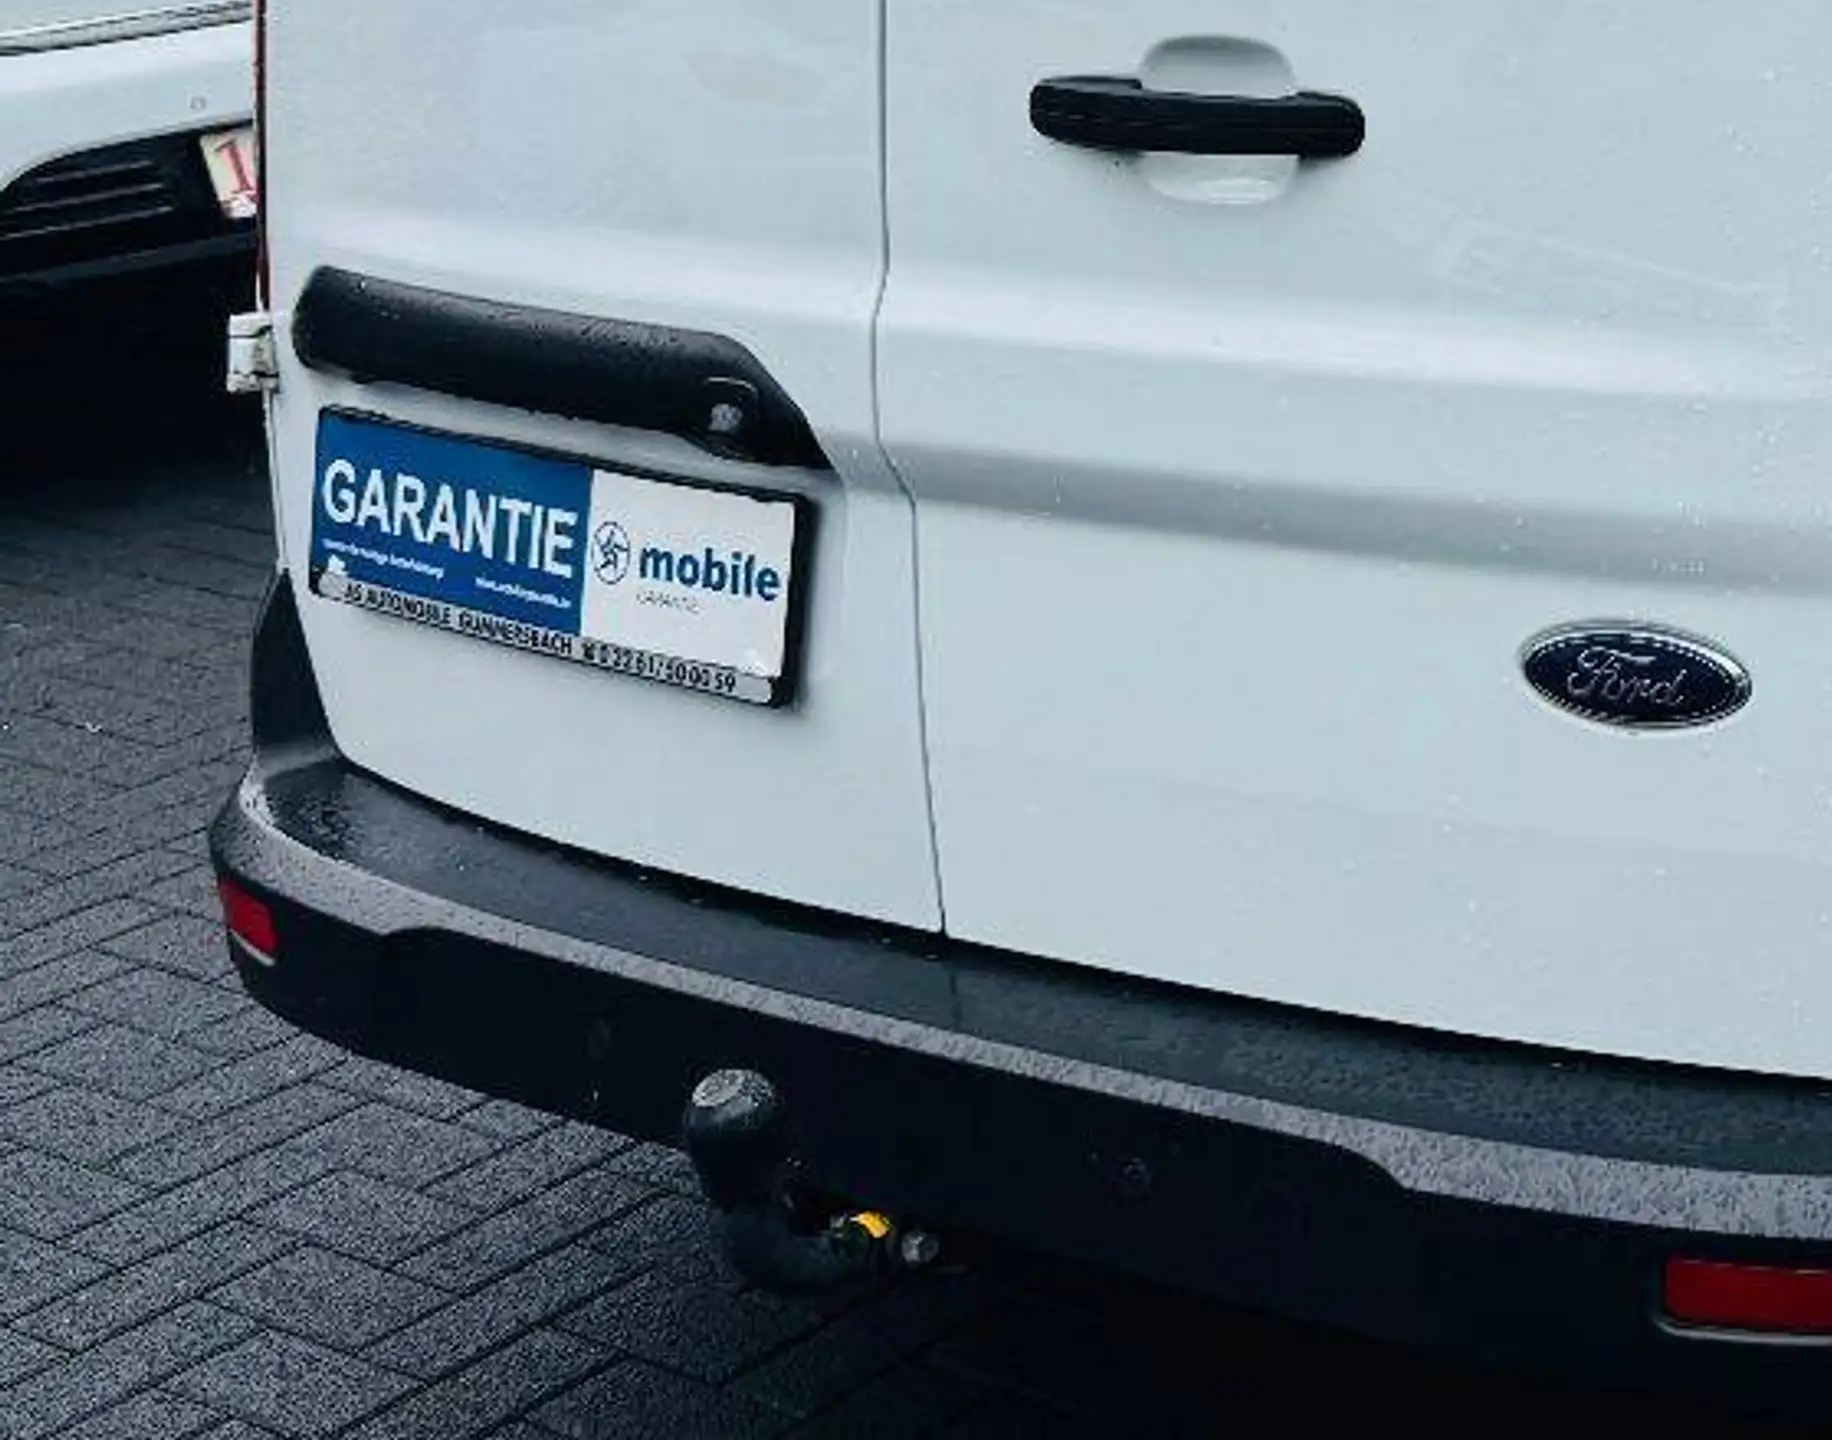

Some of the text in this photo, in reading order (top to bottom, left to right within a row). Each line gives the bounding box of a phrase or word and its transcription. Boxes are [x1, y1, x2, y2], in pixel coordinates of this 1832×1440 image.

[321, 458, 578, 580] GARANTIE
[638, 546, 780, 602] mobile
[1566, 646, 1688, 707] Ford
